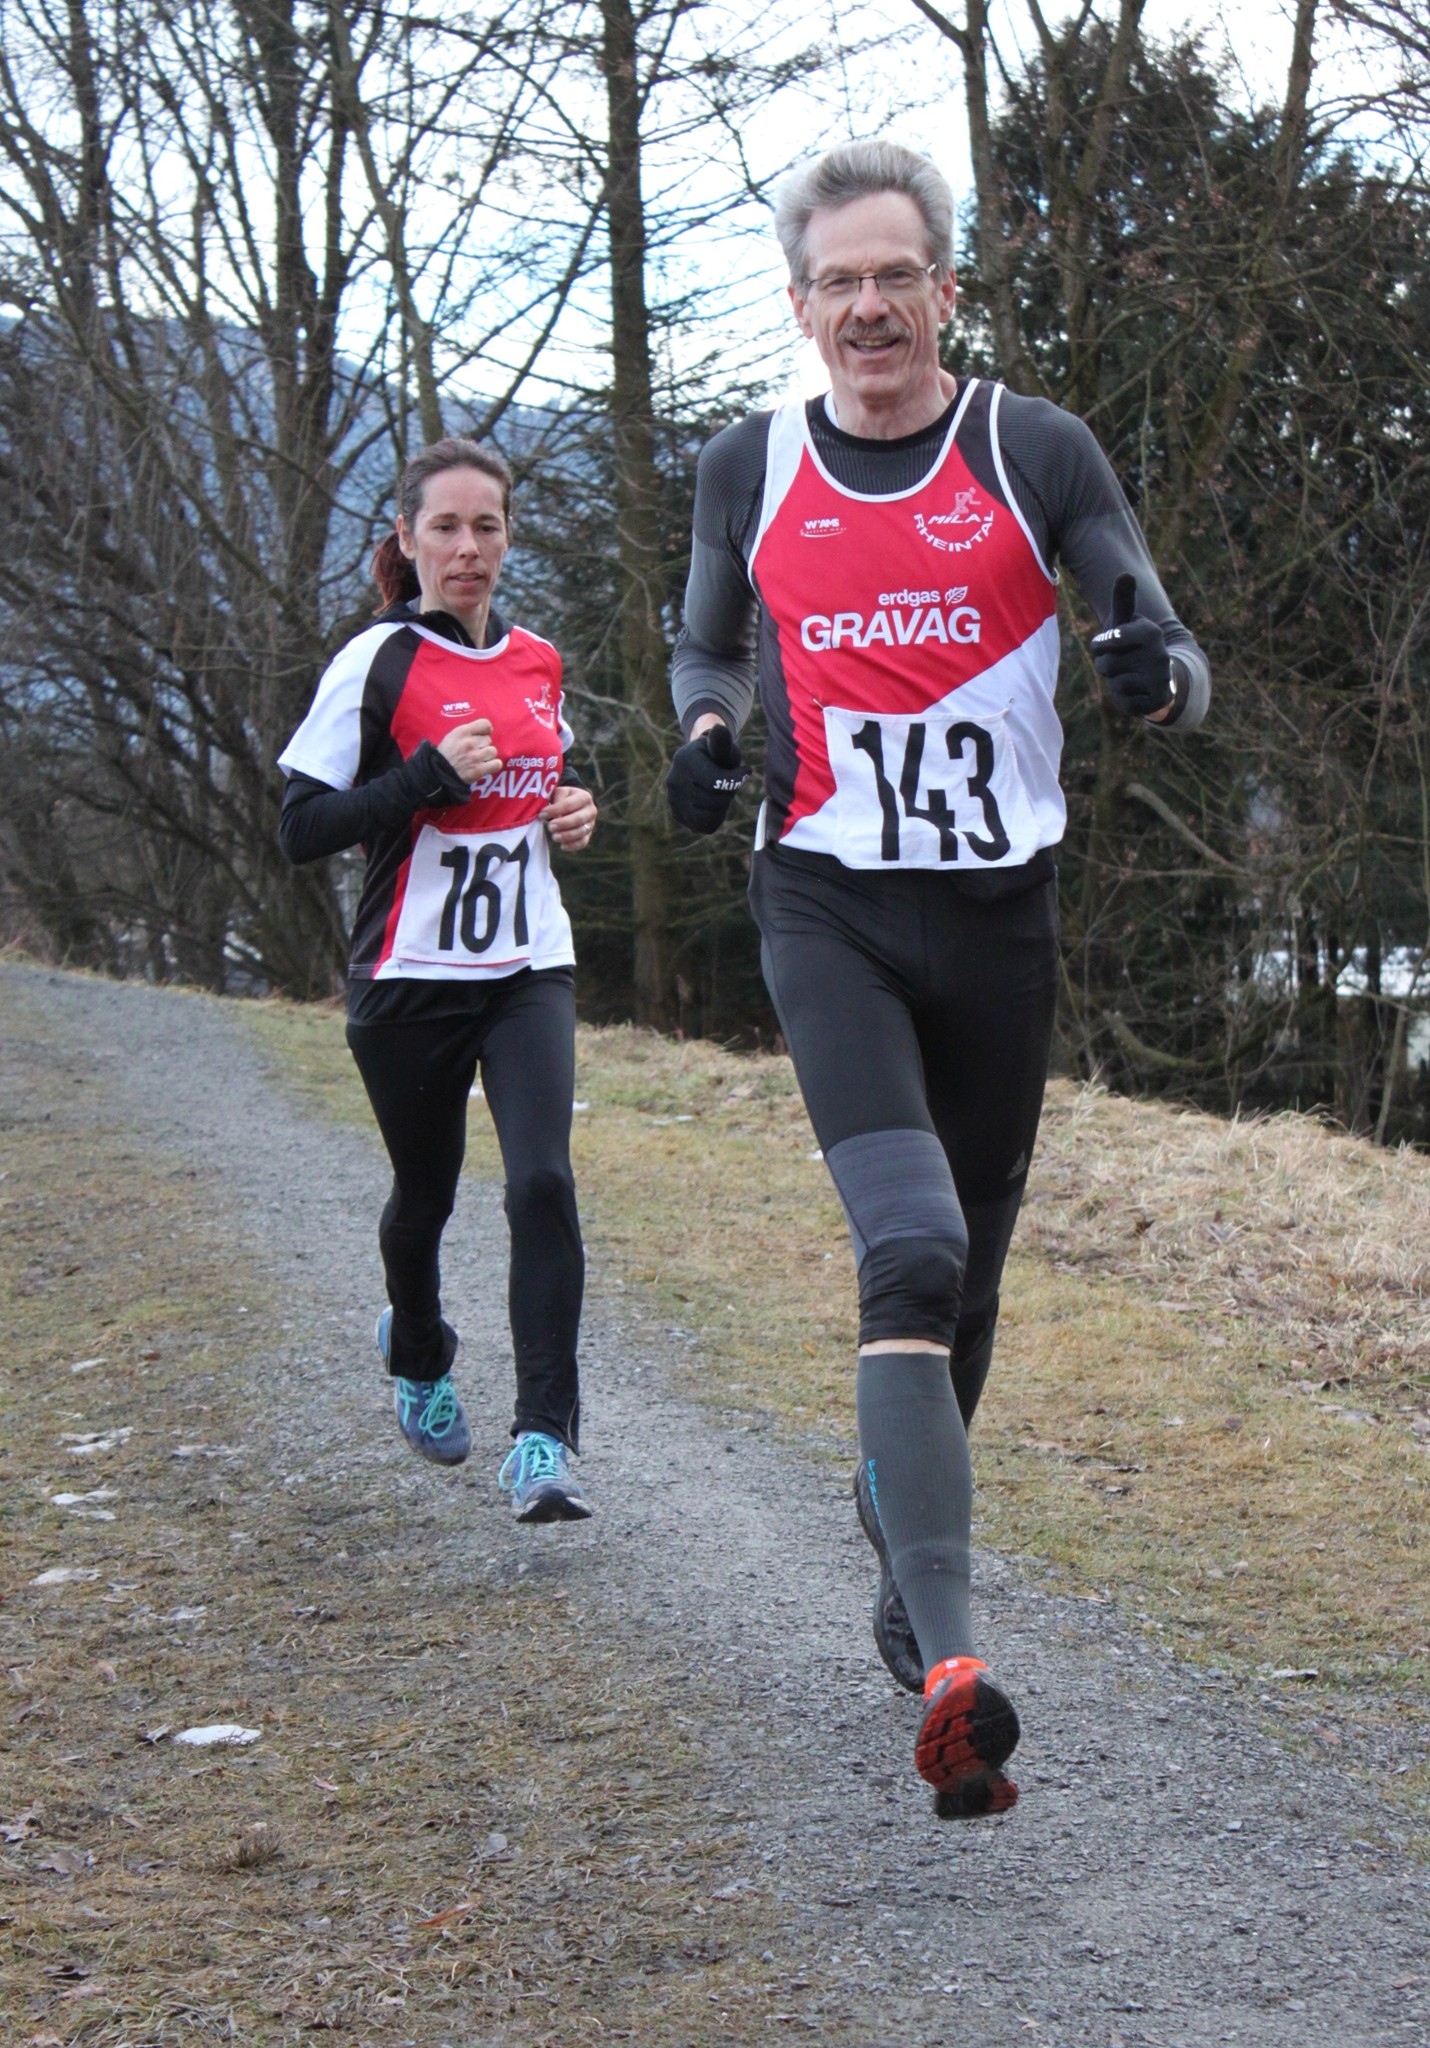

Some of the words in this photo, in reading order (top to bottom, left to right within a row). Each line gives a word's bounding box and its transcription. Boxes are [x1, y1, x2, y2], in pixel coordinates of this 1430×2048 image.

[913, 510, 994, 552] RHEINTAL
[878, 588, 940, 608] erdgas
[800, 606, 981, 652] GRAVAG
[507, 756, 544, 769] erdgas
[470, 770, 559, 799] RAVAG
[851, 719, 1011, 862] 143
[438, 836, 531, 954] 161
